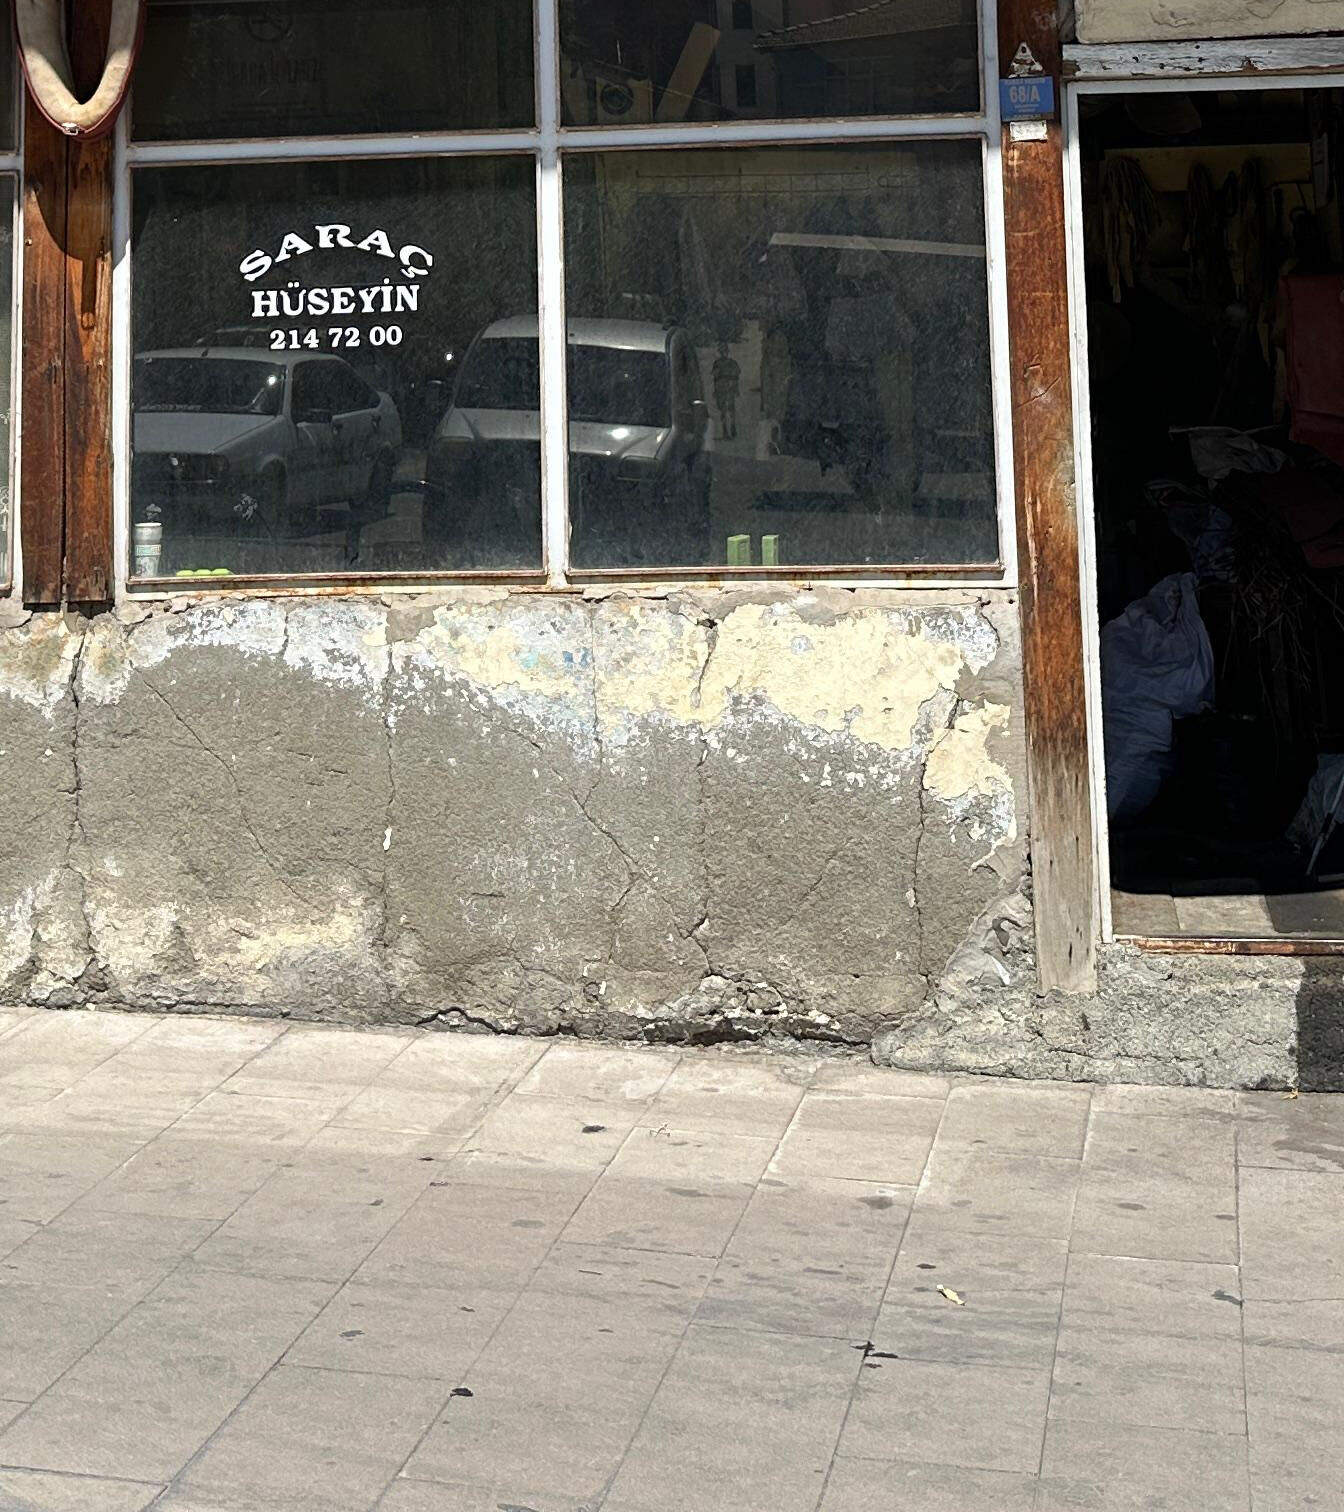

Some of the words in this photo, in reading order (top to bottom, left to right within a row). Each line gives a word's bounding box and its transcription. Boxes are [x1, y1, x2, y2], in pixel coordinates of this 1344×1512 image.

[1009, 85, 1040, 104] 68/A
[239, 224, 433, 282] SARAÇ
[251, 278, 420, 317] HÜSEYİN
[270, 329, 320, 350] 214
[328, 328, 361, 348] 72
[369, 326, 404, 346] 00
